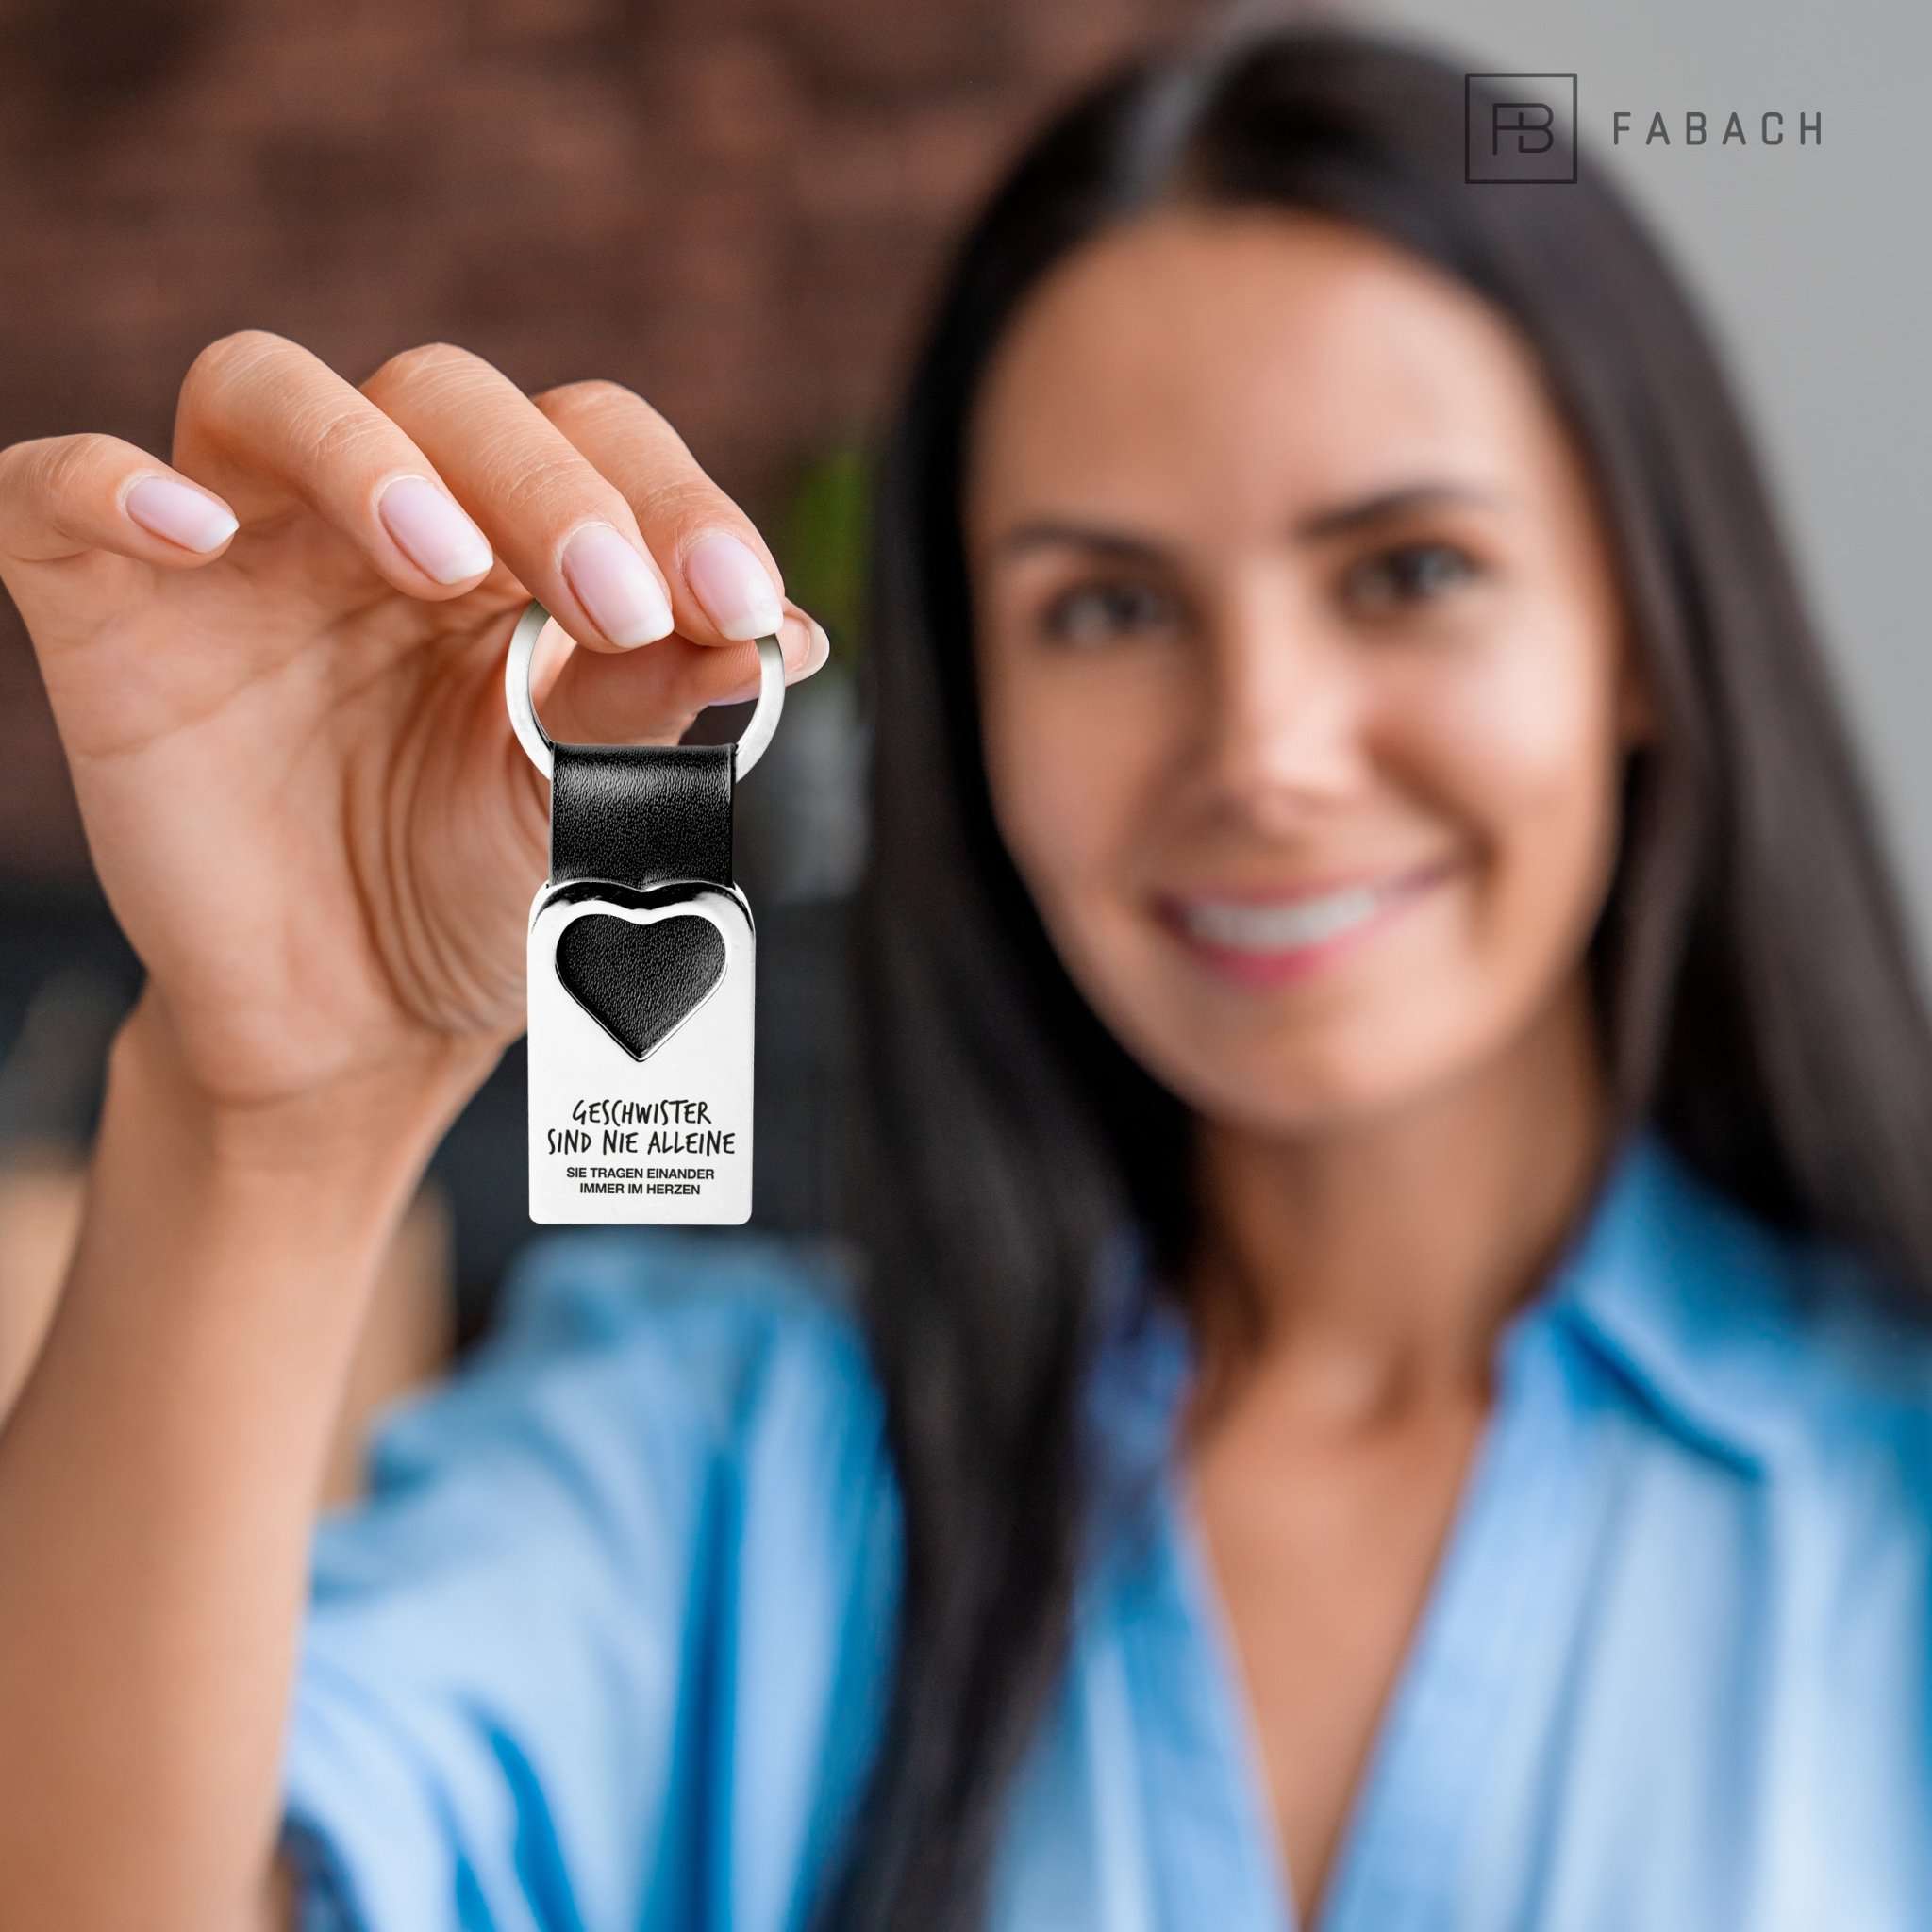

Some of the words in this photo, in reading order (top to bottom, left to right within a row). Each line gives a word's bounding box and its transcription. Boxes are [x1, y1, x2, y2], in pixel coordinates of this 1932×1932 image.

[572, 1099, 712, 1127] GESCHWISTER
[547, 1128, 592, 1156] SIND
[602, 1129, 639, 1156] NIE
[647, 1130, 736, 1157] ALLEINE
[566, 1166, 587, 1178] SIE
[590, 1167, 643, 1179] TRAGEN
[646, 1168, 715, 1180] EINANDER
[579, 1182, 625, 1194] IMMER
[627, 1183, 643, 1194] IM
[646, 1183, 701, 1195] HERZEN
